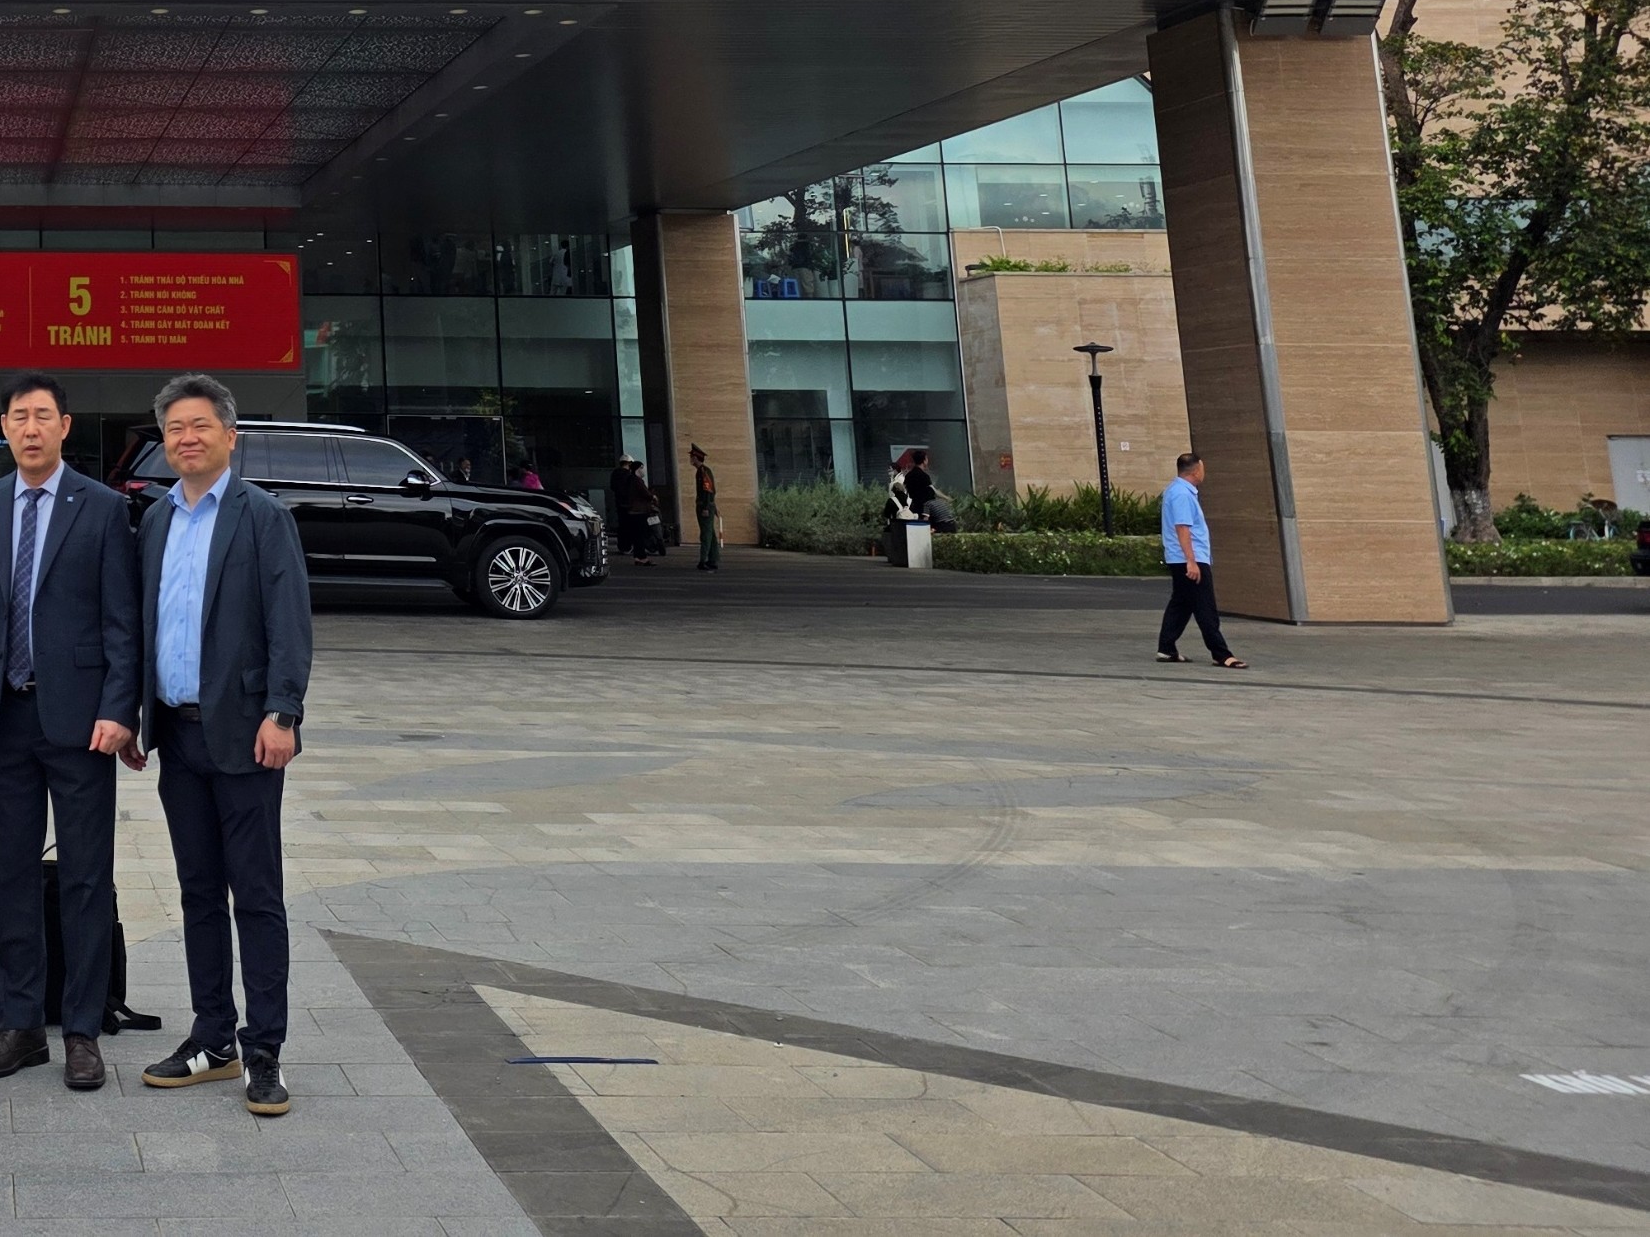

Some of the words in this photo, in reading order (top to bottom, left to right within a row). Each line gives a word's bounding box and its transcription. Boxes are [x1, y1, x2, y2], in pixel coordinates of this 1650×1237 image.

[130, 275, 155, 285] TRÁNH
[156, 275, 173, 285] THÁI
[69, 276, 92, 316] 5
[130, 290, 155, 299] TRÁNH
[130, 305, 155, 314] TRÁNH
[130, 319, 155, 329] TRÁNH
[47, 322, 112, 346] TRÁNH
[130, 334, 155, 344] TRÁNH
